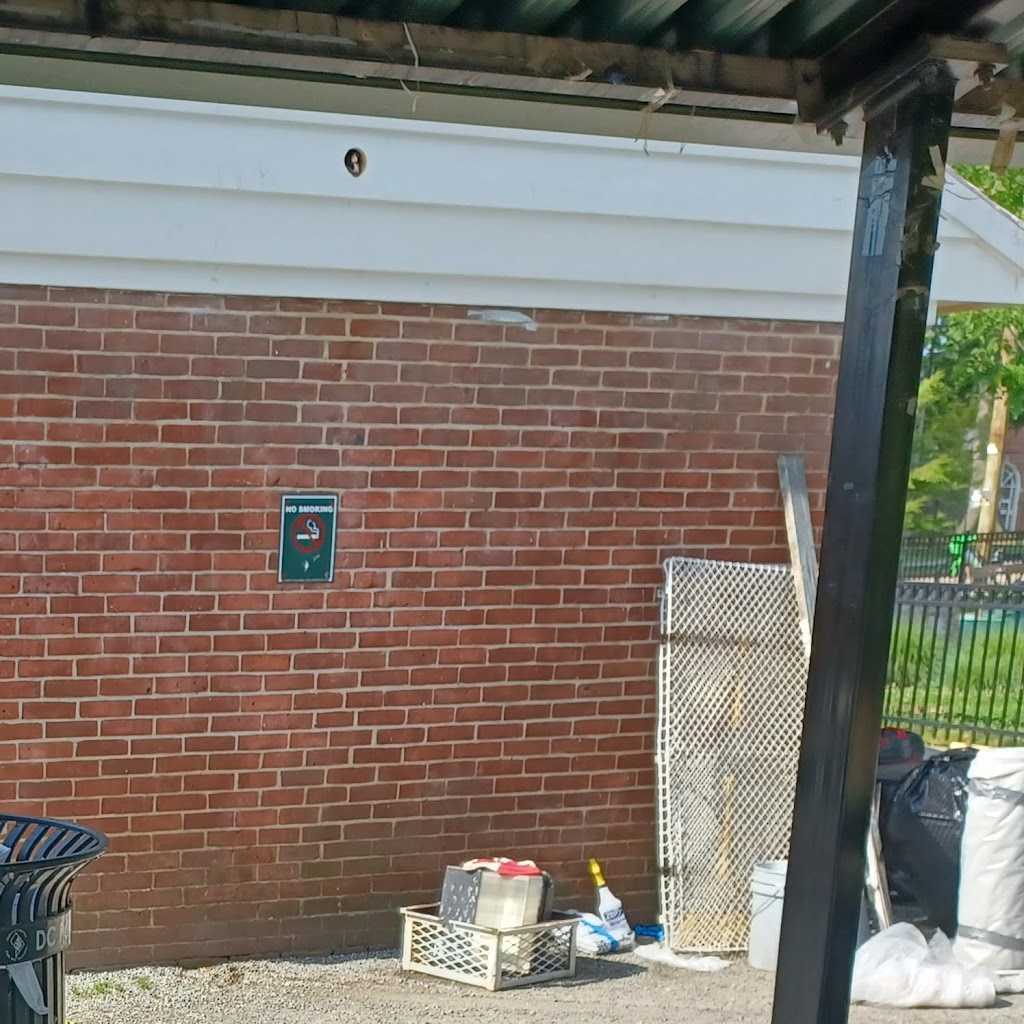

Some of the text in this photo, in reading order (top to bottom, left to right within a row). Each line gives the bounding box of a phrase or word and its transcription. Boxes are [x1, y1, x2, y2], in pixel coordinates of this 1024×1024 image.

[285, 505, 333, 513] NO SMOKING
[36, 925, 57, 951] DC
